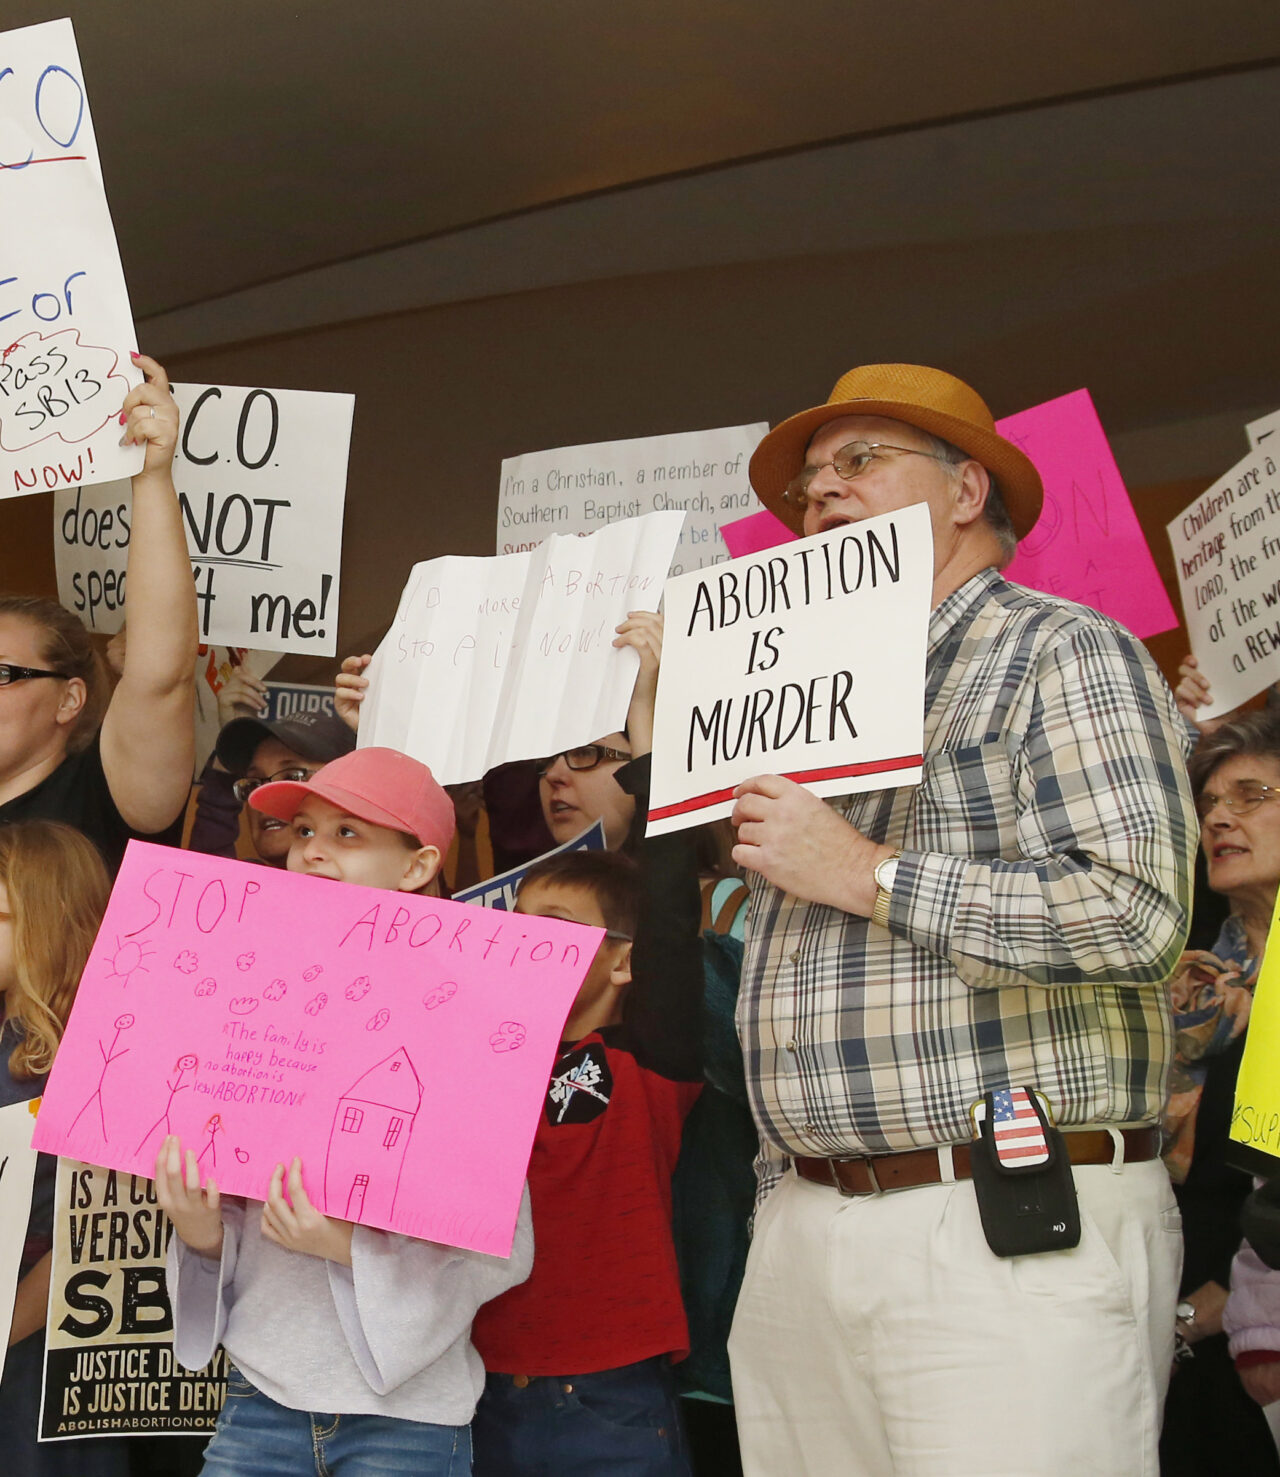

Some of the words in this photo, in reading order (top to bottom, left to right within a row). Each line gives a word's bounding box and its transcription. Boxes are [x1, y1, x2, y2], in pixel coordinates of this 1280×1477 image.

[13, 367, 102, 431] SB13
[13, 447, 95, 491] NOW!
[504, 475, 525, 496] I'm
[531, 478, 540, 493] a
[637, 470, 645, 484] a
[653, 460, 718, 482] member
[724, 453, 744, 475] of
[502, 504, 568, 528] Southern
[584, 499, 642, 523] Baptist
[653, 491, 715, 514] Church,
[720, 485, 751, 509] and
[1183, 487, 1235, 541] Children
[1238, 465, 1260, 498] are
[1266, 456, 1277, 476] a
[62, 486, 131, 550] does
[179, 492, 291, 561] NOT
[691, 526, 709, 544] be
[1181, 532, 1226, 580] heritage
[1230, 506, 1266, 540] from
[687, 522, 900, 637] ABORTION
[1231, 553, 1257, 581] the
[250, 574, 333, 639] me!
[1209, 608, 1226, 643] of
[1232, 598, 1259, 627] the
[745, 626, 784, 676] IS
[1233, 653, 1246, 673] a
[687, 670, 858, 772] MURDER
[124, 868, 261, 938] STOP
[225, 1043, 263, 1066] happy
[269, 1048, 318, 1072] because
[264, 1024, 309, 1052] family
[312, 1038, 327, 1055] is
[204, 1061, 219, 1071] no
[221, 1063, 269, 1080] abortion
[272, 1070, 285, 1082] is
[70, 1169, 93, 1210] IS
[103, 1169, 118, 1207] A
[70, 1349, 150, 1383] JUSTICE
[62, 1387, 81, 1416] IS
[88, 1381, 171, 1413] JUSTICE
